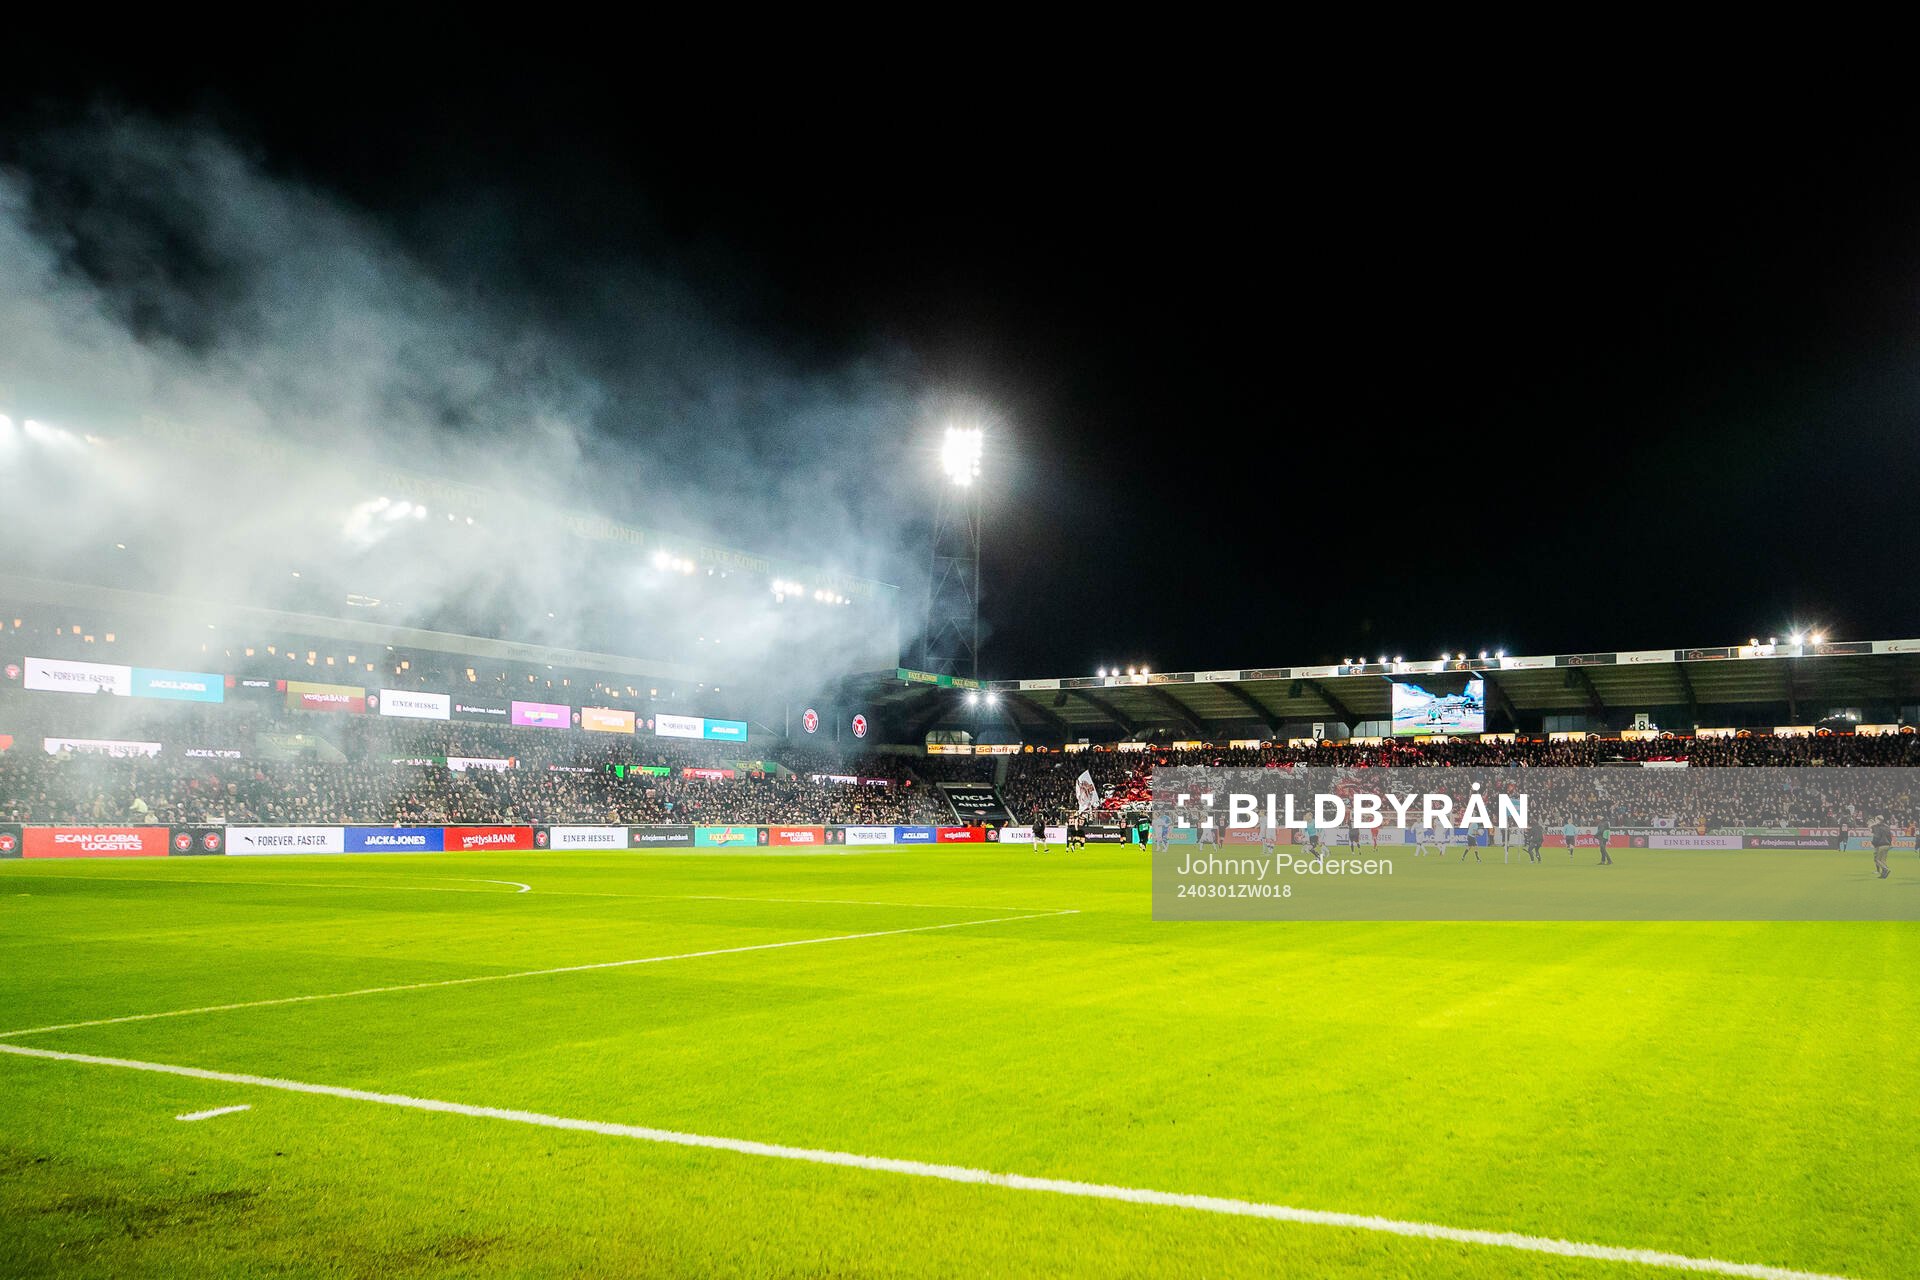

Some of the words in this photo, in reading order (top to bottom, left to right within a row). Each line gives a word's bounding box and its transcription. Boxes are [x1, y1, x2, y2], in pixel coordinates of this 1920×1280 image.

[1638, 721, 1645, 731] 8
[1315, 729, 1322, 739] 7
[55, 834, 93, 843] SCAN
[94, 834, 142, 843] GLOBAL
[258, 836, 295, 846] FOREVER.
[297, 835, 328, 846] FASTER.
[364, 835, 426, 846] JACK&JONES
[462, 834, 516, 846] vestjyskBANK
[563, 834, 586, 842] EJNER
[588, 834, 615, 842] HESSEL
[82, 842, 142, 851] LOGISTICS
[1664, 839, 1691, 847] EJNER
[1761, 839, 1796, 847] Arbejdernes
[1797, 839, 1829, 847] Landsbank
